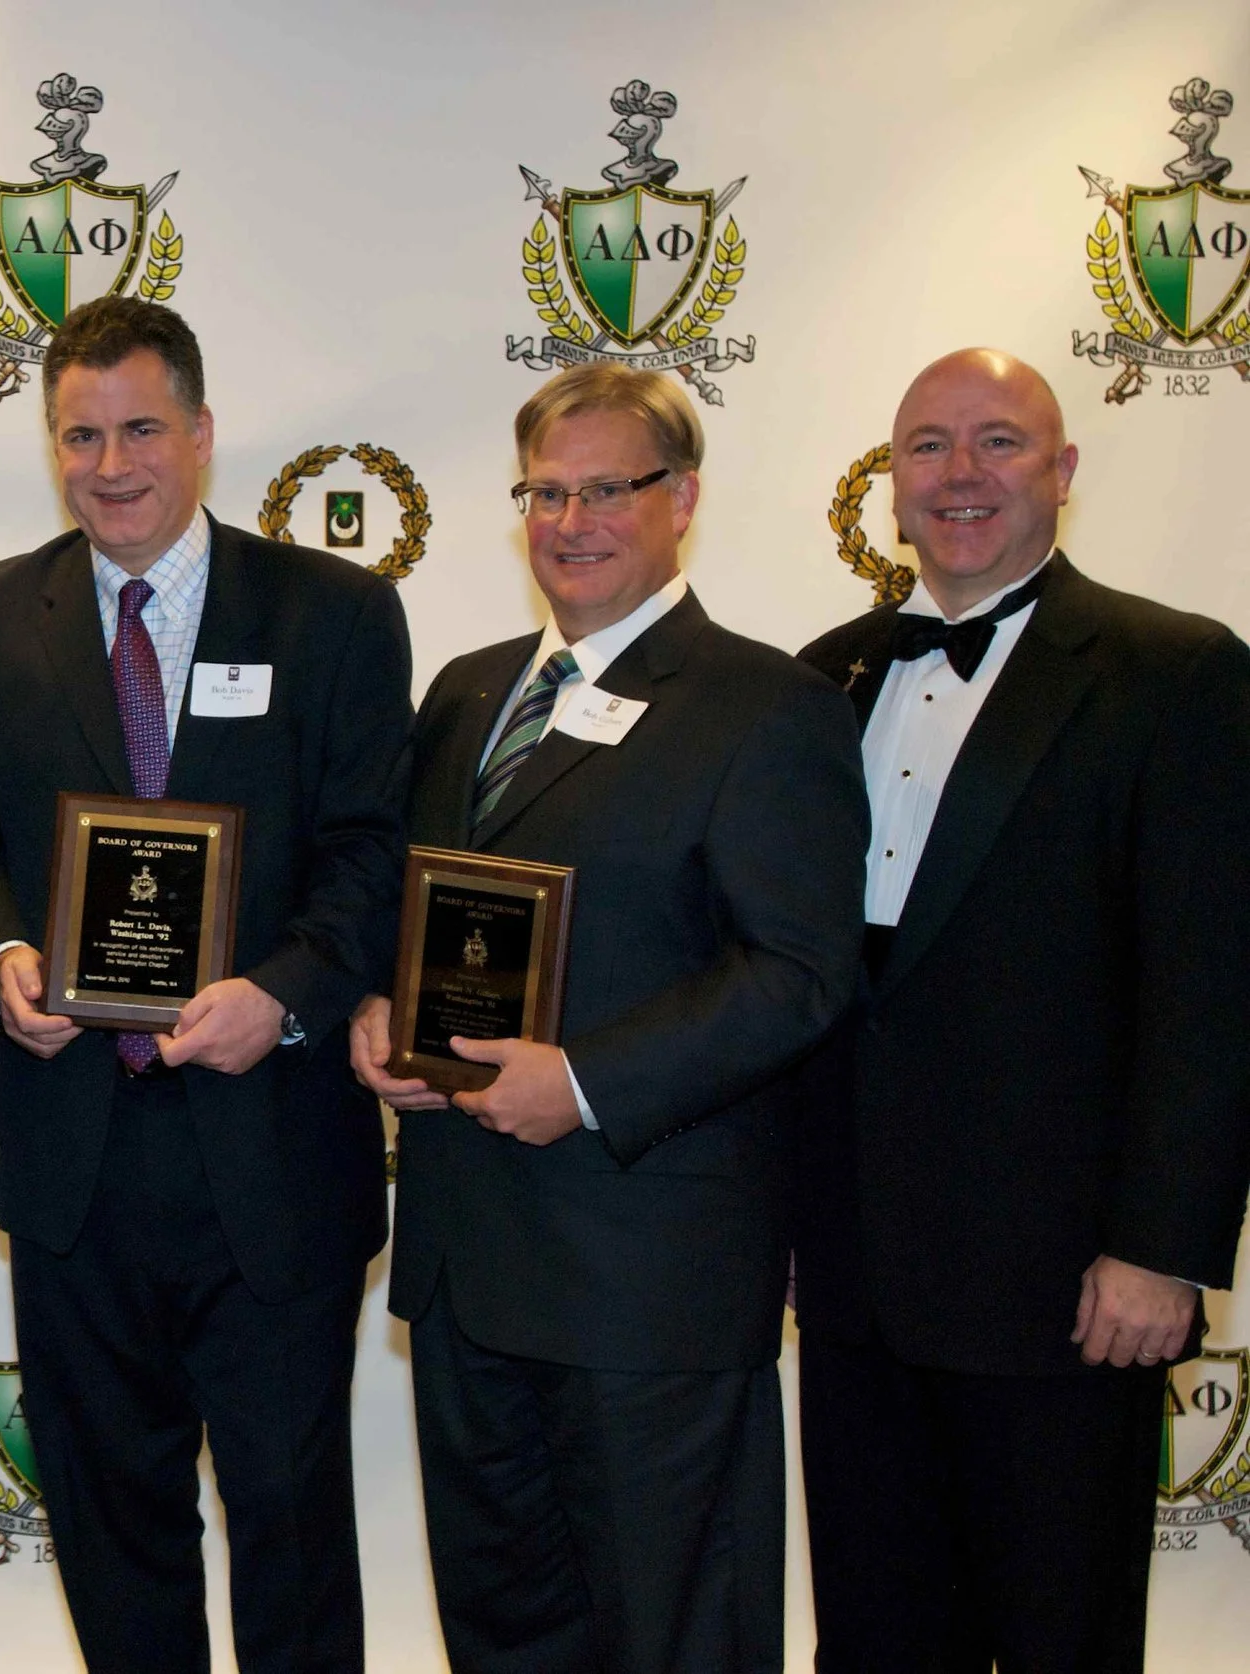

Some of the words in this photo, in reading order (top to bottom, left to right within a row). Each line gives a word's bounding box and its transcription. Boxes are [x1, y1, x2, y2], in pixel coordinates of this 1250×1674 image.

[642, 351, 670, 368] COR
[673, 342, 709, 362] UNUM
[1199, 351, 1226, 366] COR
[1163, 374, 1210, 396] 1832
[97, 837, 128, 846] BOARD
[130, 839, 142, 847] OF
[144, 840, 198, 852] GOVERNORS
[132, 850, 162, 858] AWARD
[109, 920, 134, 929] Robert
[137, 922, 145, 930] L.
[110, 929, 154, 940] Washington
[1164, 1379, 1232, 1417] ΔΦ
[33, 1543, 55, 1563] 18
